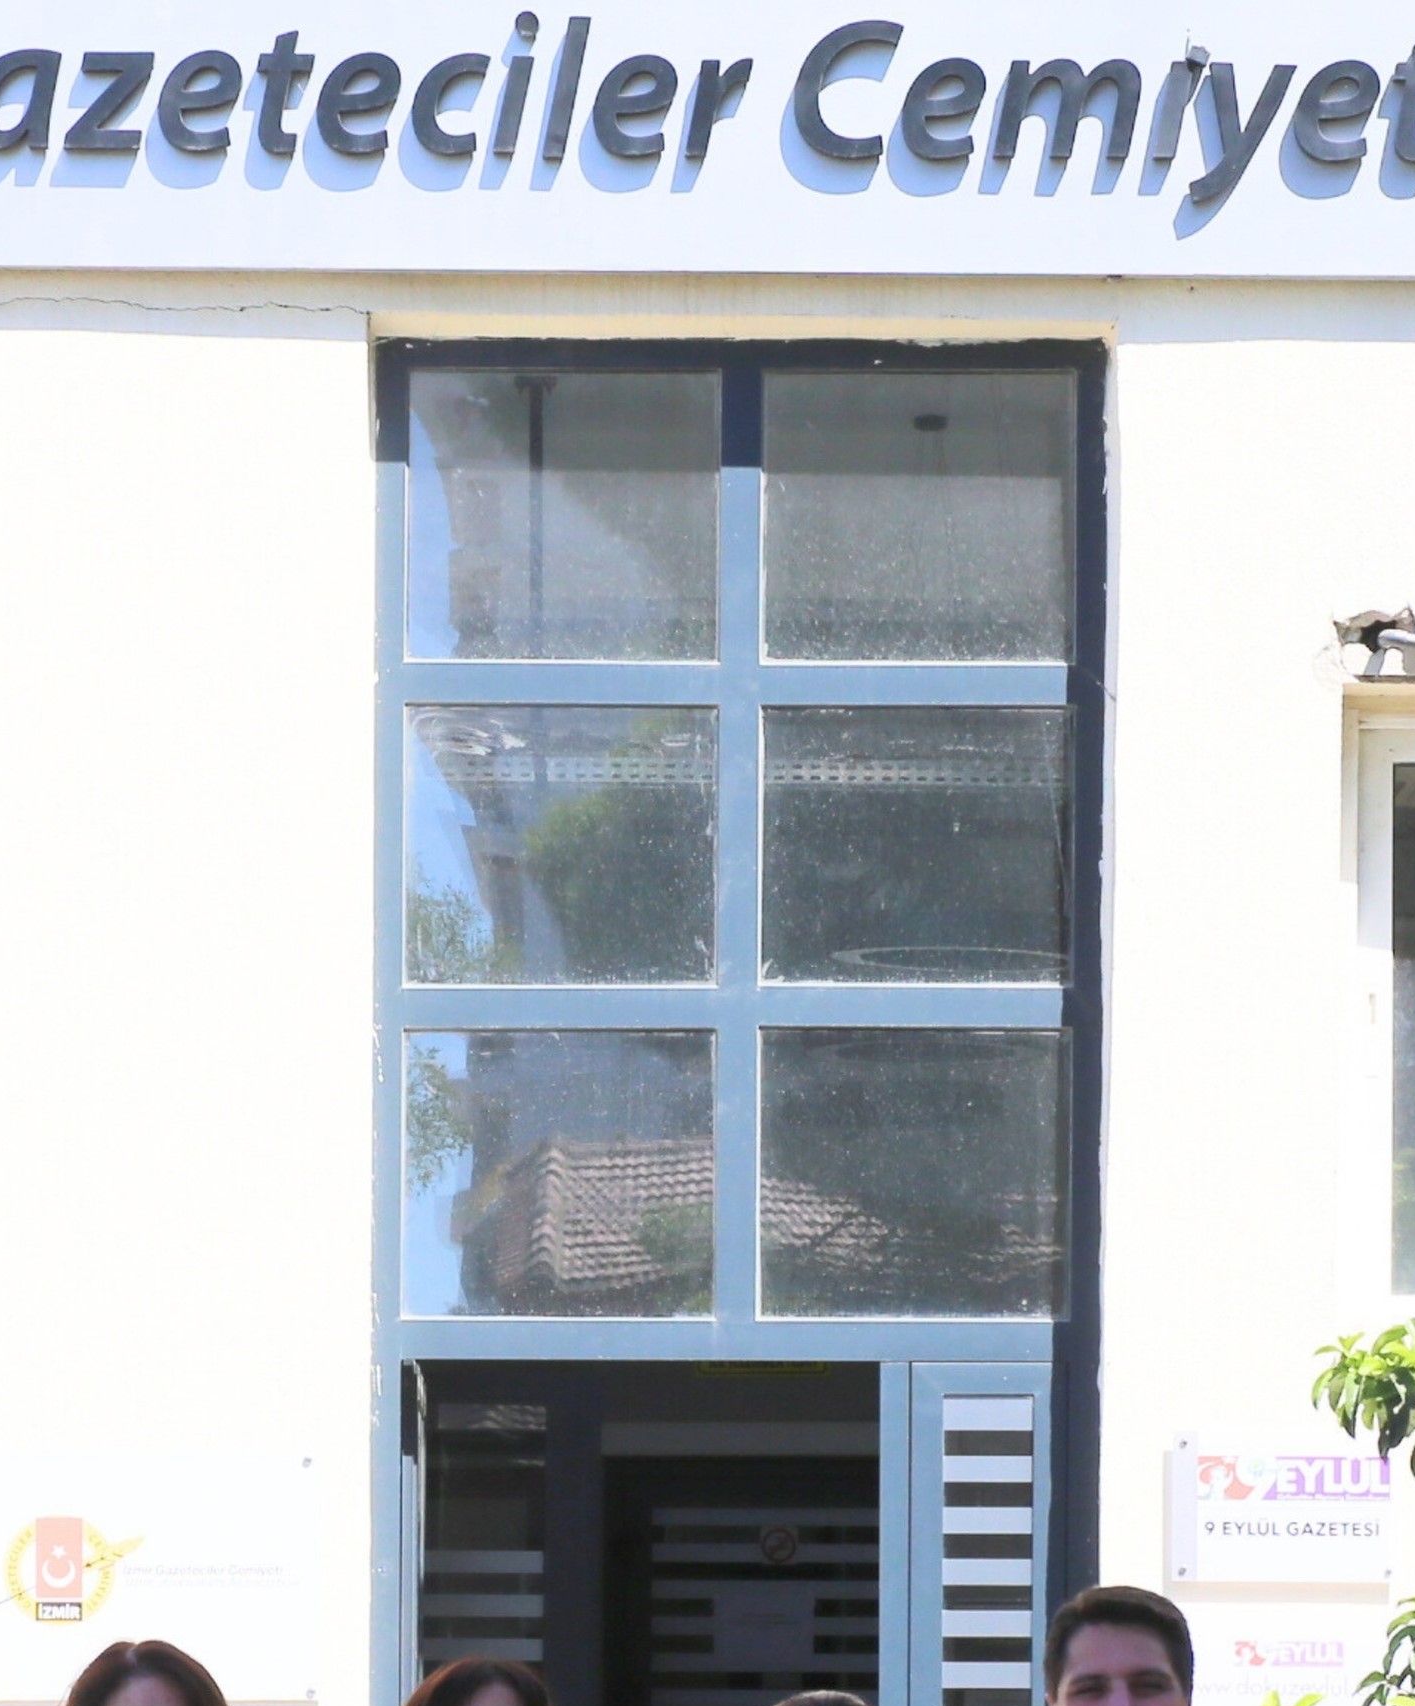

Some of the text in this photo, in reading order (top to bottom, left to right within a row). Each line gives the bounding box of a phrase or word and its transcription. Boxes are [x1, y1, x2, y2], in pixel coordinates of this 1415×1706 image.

[1204, 1518, 1381, 1537] 9 EYLÜL GAZETESİ
